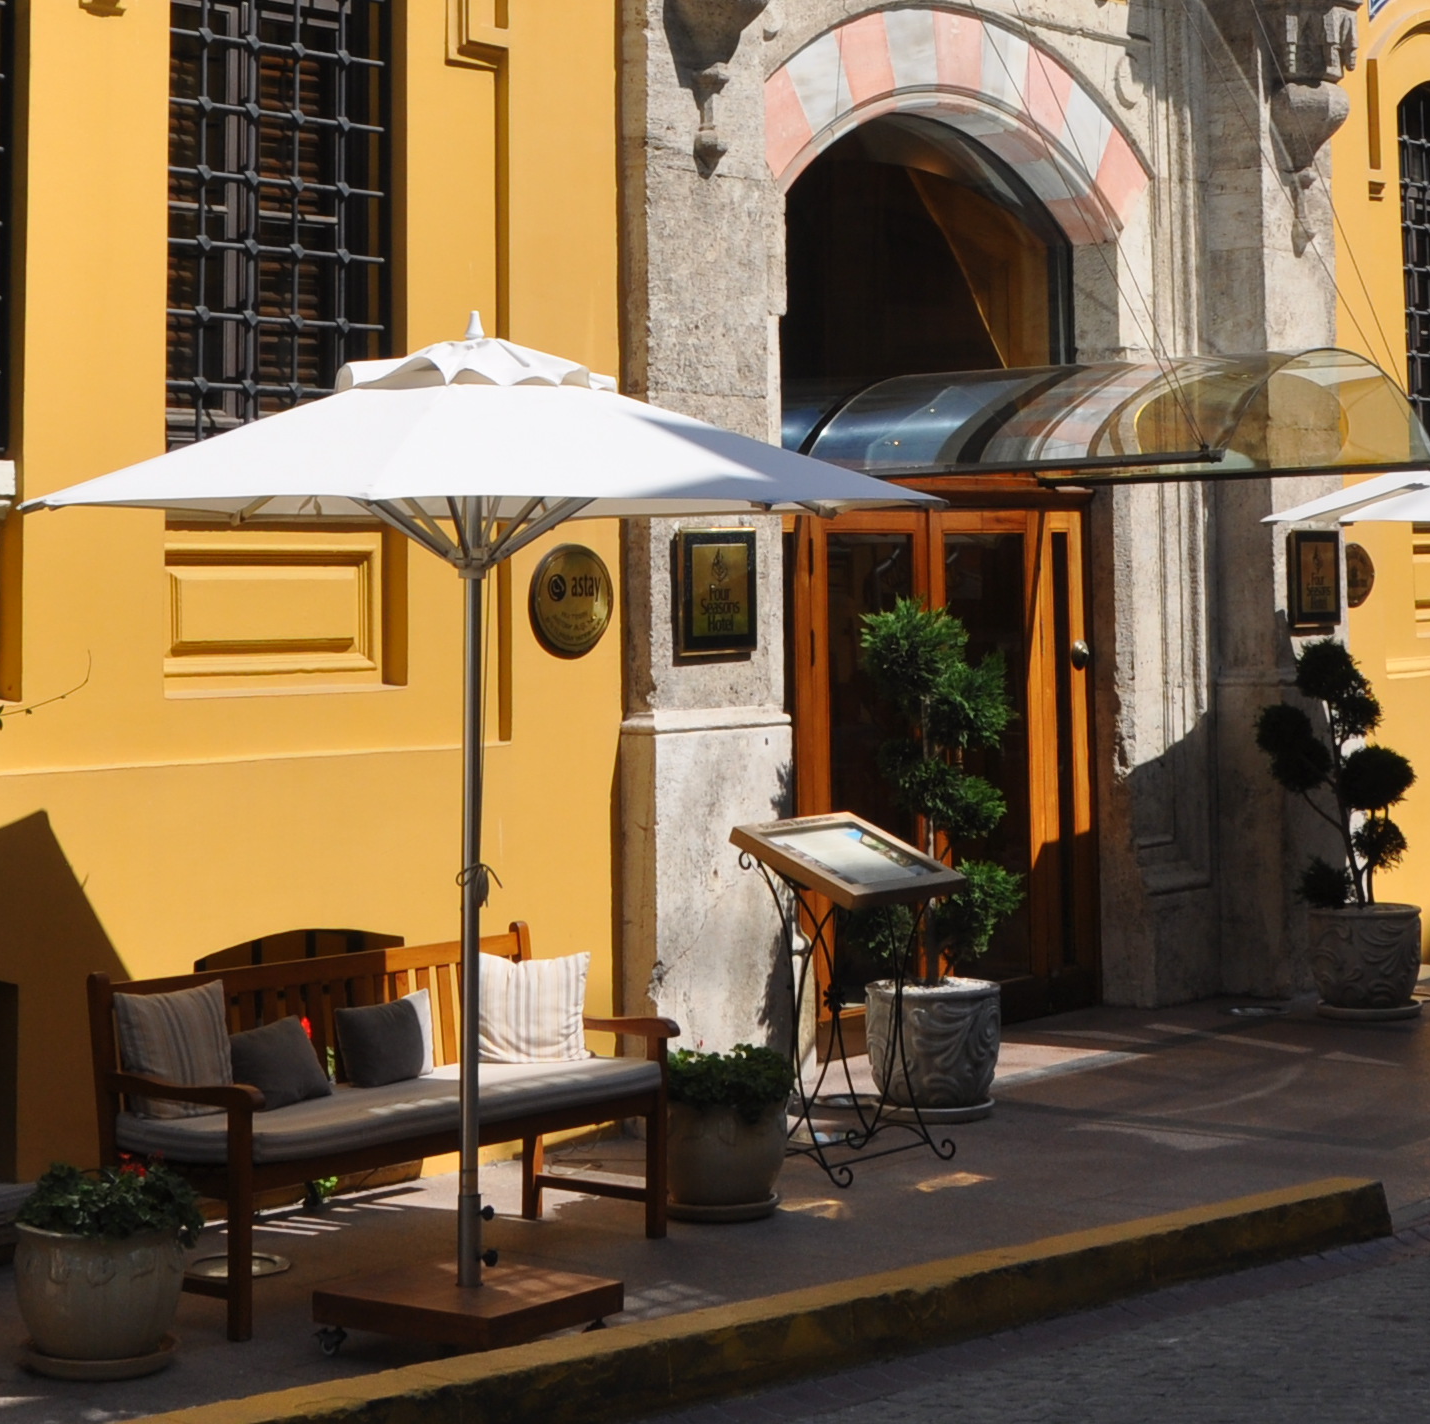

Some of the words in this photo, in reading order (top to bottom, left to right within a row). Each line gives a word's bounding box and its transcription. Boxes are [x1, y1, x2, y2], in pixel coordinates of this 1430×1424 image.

[571, 574, 601, 601] astay
[709, 584, 731, 601] Four
[700, 598, 741, 616] Seasons
[707, 615, 734, 632] Hotel
